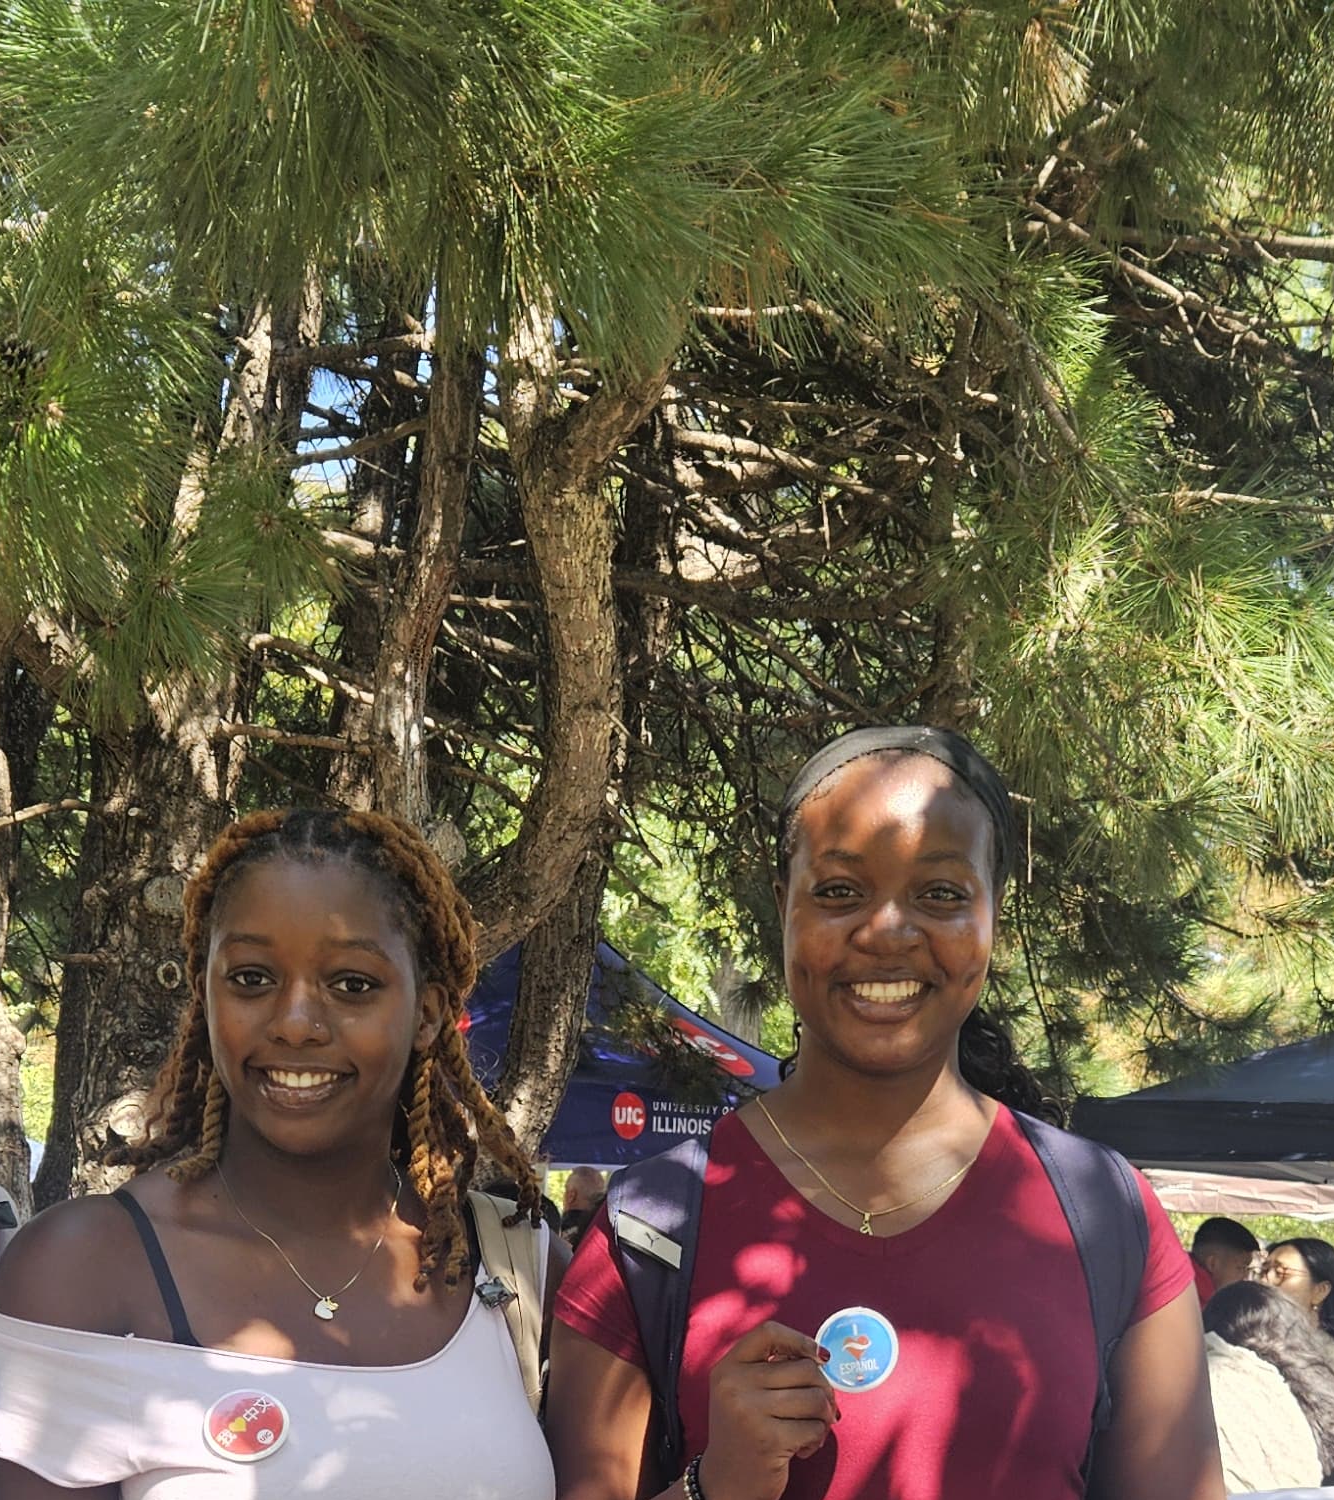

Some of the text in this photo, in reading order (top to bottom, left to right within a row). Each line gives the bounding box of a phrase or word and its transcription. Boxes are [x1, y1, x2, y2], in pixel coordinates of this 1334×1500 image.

[614, 1105, 643, 1125] UIC
[652, 1101, 718, 1115] UNIVERSITY
[652, 1117, 712, 1135] ILLINOIS
[242, 1396, 275, 1422] 中文
